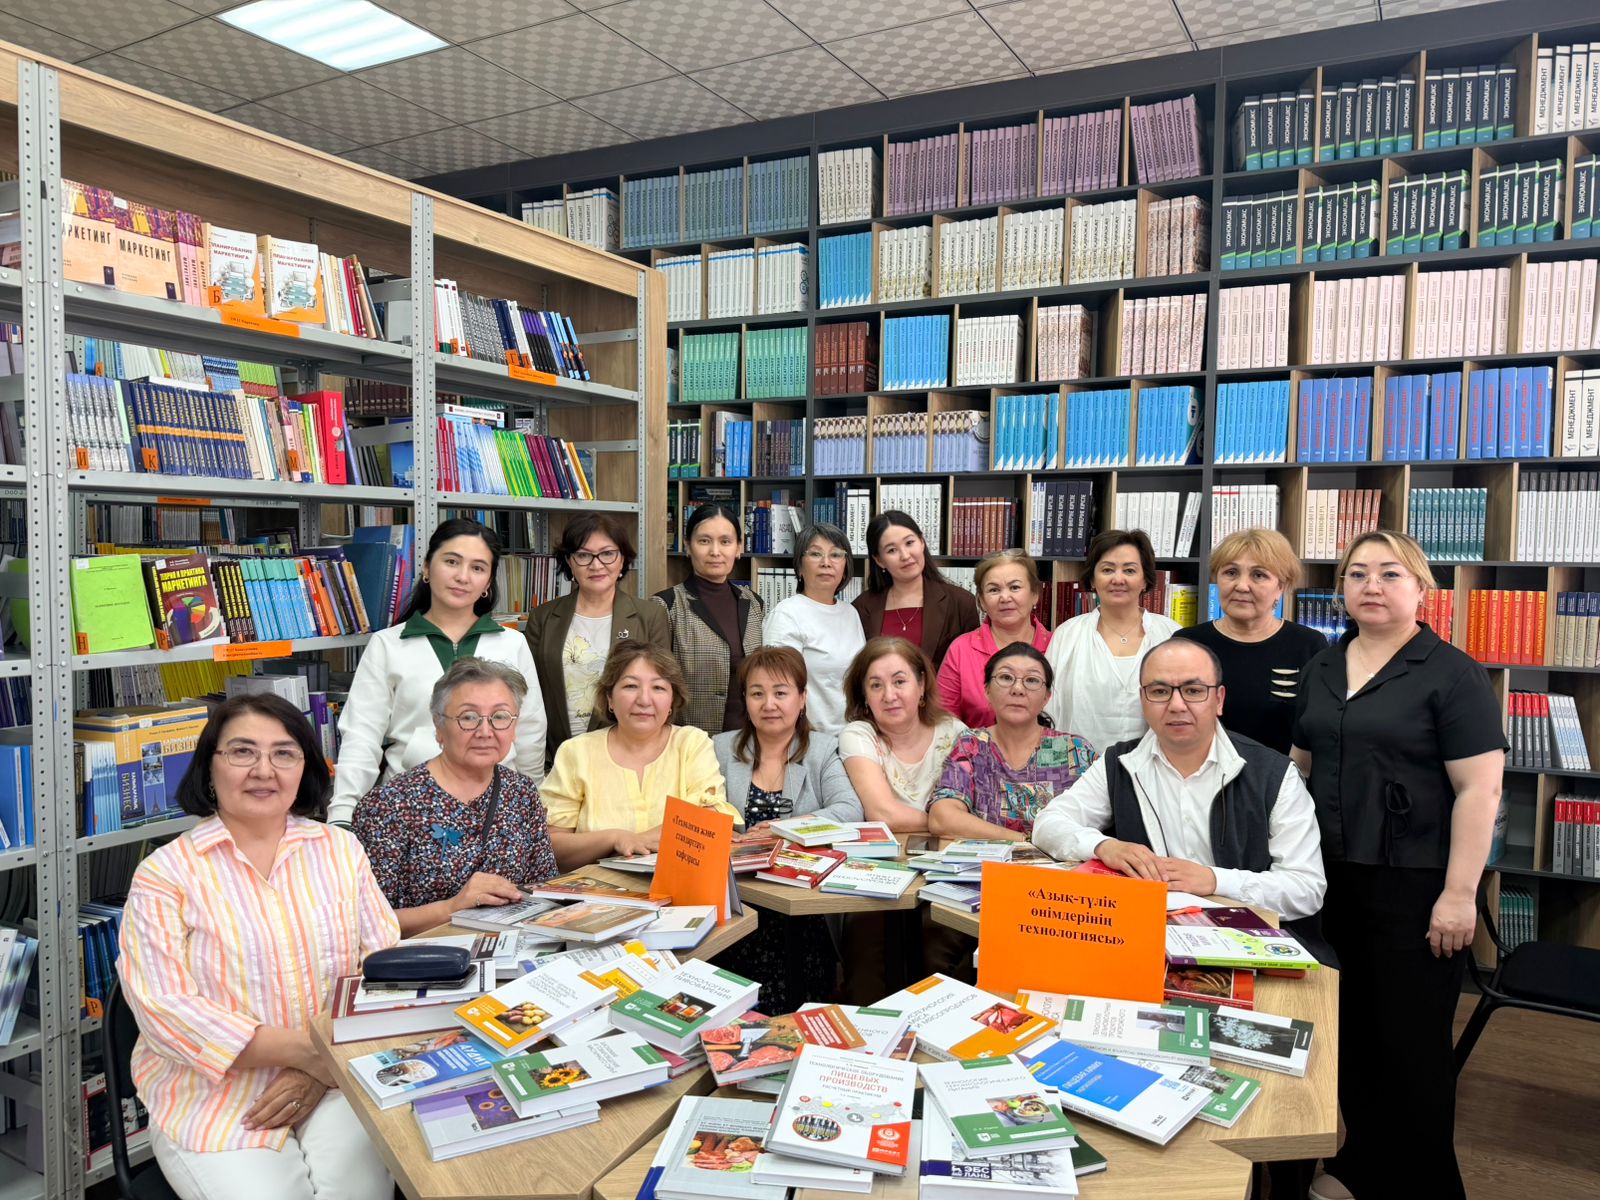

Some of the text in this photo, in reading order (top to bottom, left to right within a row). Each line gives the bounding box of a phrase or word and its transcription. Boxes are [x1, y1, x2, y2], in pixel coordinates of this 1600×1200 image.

[62, 222, 111, 244] АРКЕТИНГ
[120, 239, 170, 262] МАРКЕТИНГ
[211, 243, 252, 253] ПЛАНИРОВАНИЕ
[213, 250, 249, 260] МАРКЕТИНГА
[273, 253, 314, 264] ПЛАНИРОВАНИЕ
[277, 260, 311, 269] МАРКЕТИНГА
[213, 290, 220, 304] Б
[1567, 389, 1577, 440] МЕНЕДЖМЕНТ
[1587, 388, 1595, 439] МЕНЕДЖМЕНТ
[148, 454, 156, 468] К
[162, 575, 207, 593] МАРКЕТИНГА
[163, 741, 198, 754] БИЗН
[121, 772, 132, 812] БИЗНЕС
[1028, 888, 1117, 909] «Азық-түлік
[1031, 907, 1112, 927] өнімдерінің
[1018, 924, 1125, 946] технологиясы»
[810, 1060, 859, 1074] ТЕХНОЛОГИЧЕСКОЕ
[819, 1075, 888, 1093] ПРОИЗВОДСТВ
[831, 1070, 880, 1084] ПИЩЕВЫХ
